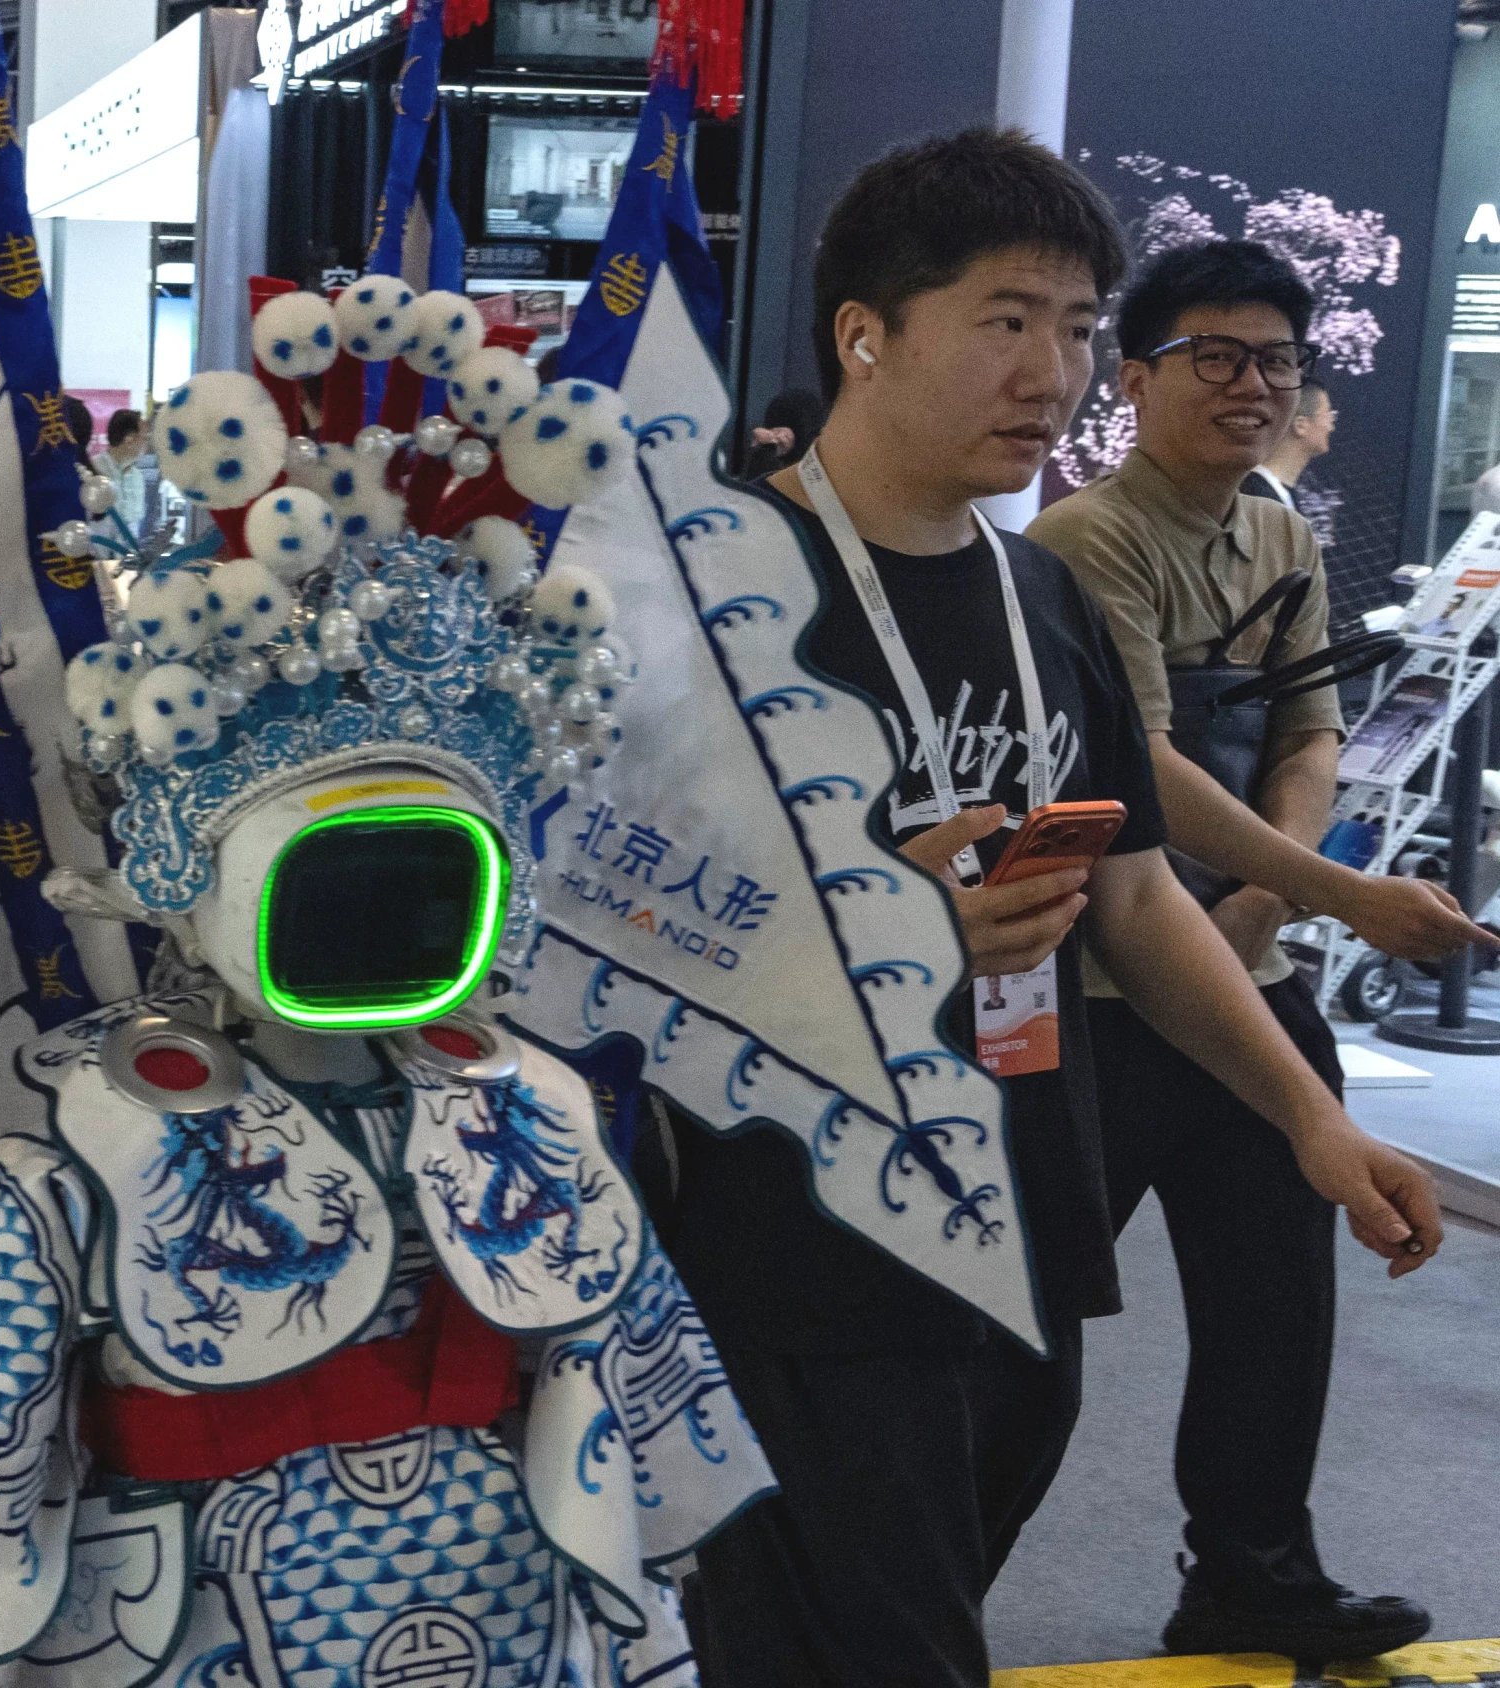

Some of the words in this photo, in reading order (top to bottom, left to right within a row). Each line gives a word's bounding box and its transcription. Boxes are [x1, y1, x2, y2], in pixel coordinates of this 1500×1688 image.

[576, 802, 779, 931] 北京人形
[981, 1039, 1028, 1055] EXHIBITOR
